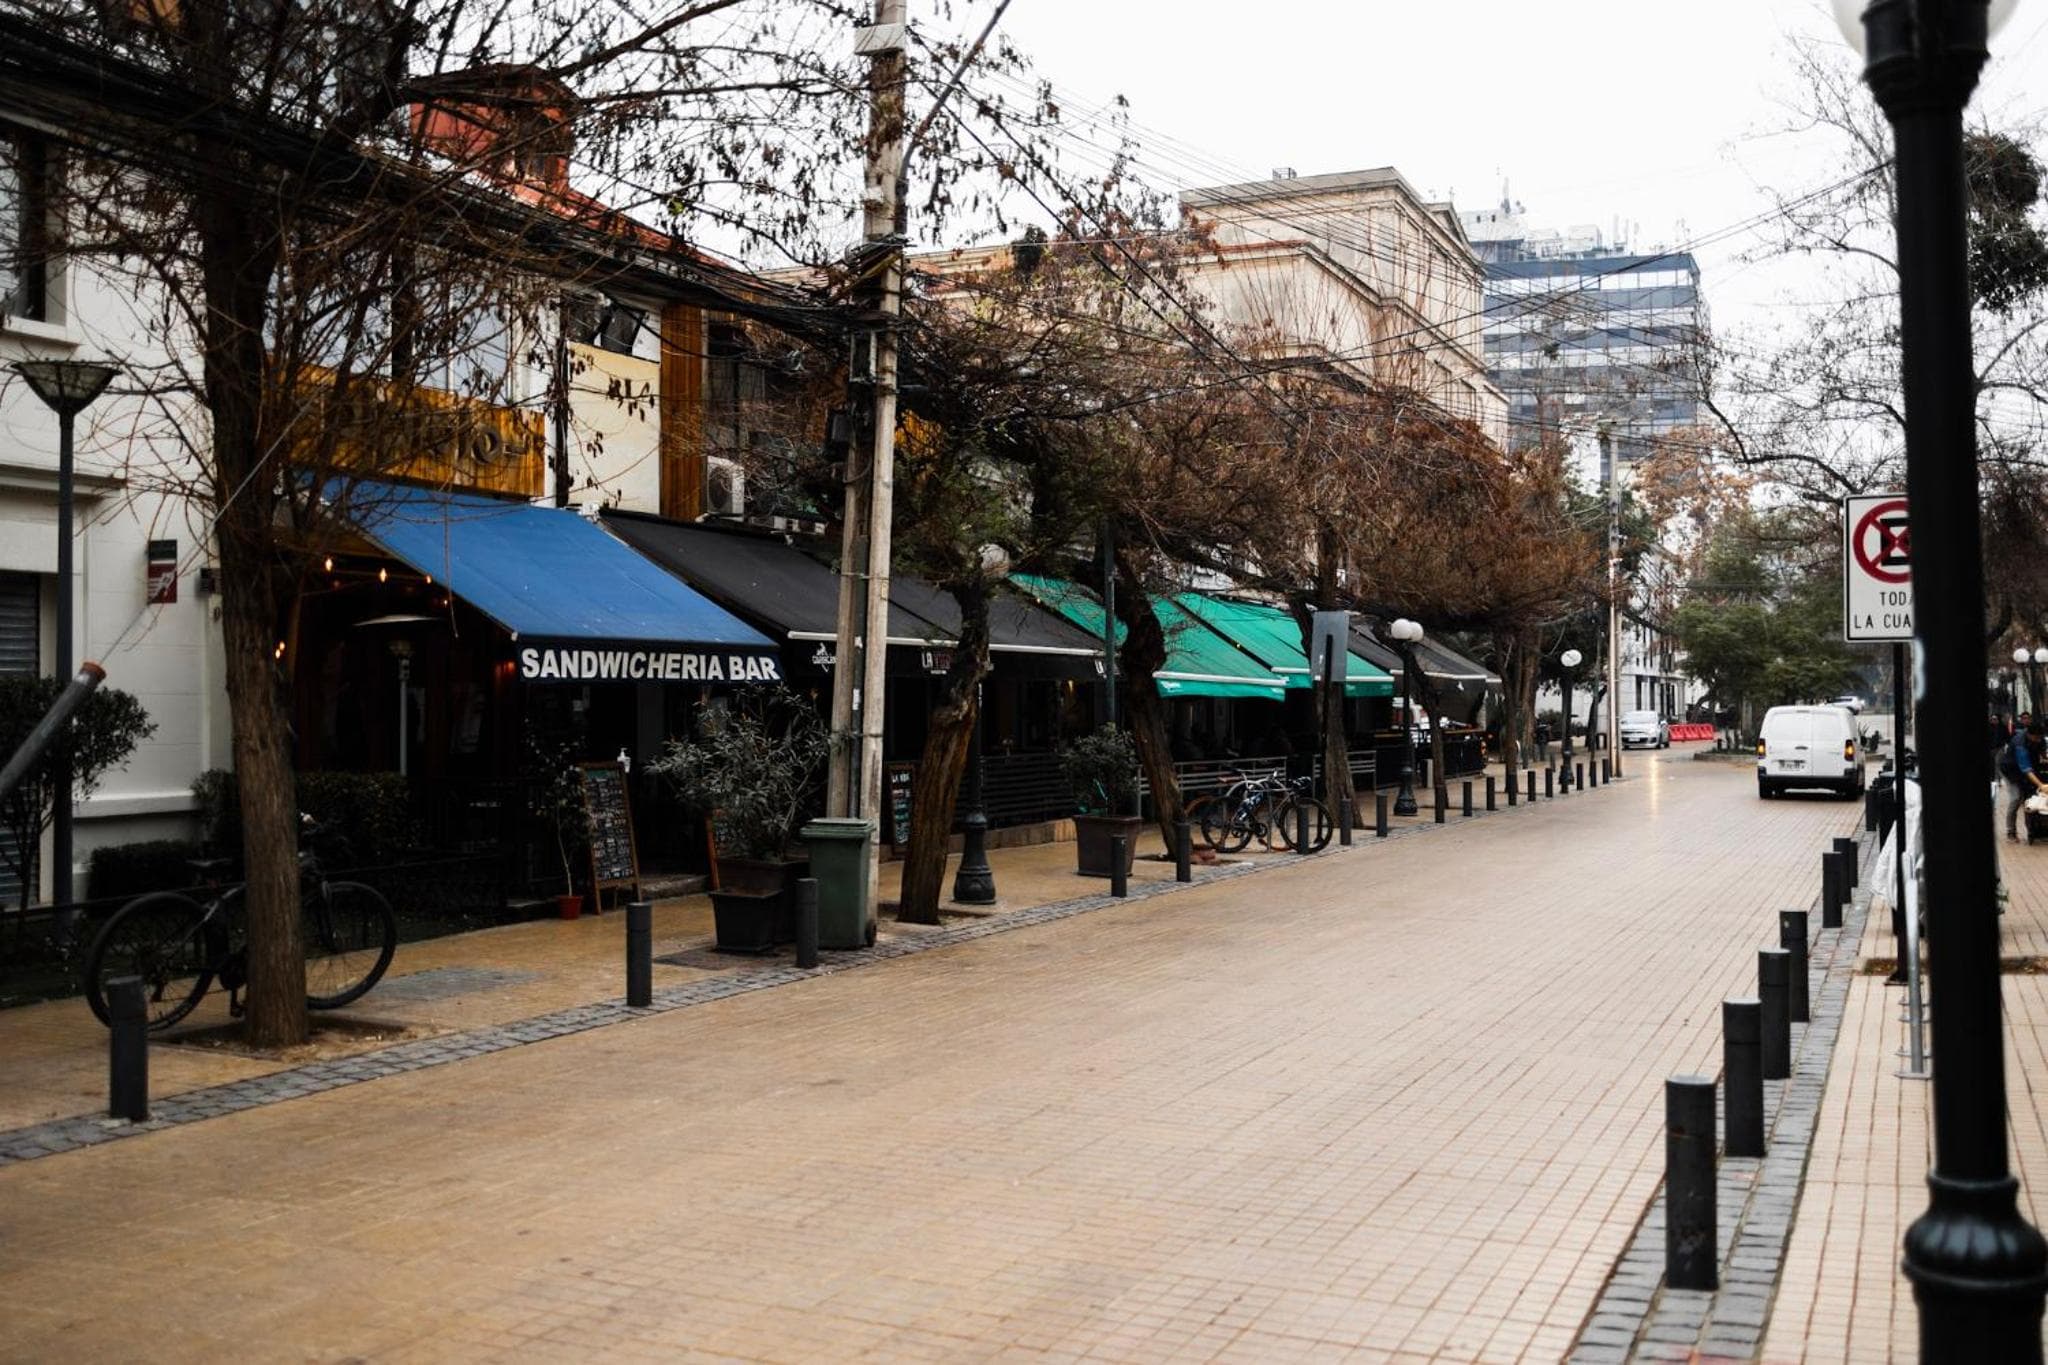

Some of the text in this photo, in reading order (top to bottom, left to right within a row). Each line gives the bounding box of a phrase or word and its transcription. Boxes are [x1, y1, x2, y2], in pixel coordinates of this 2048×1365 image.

[1854, 613, 1912, 629] LA CUA
[521, 648, 781, 681] SANDWICHERIA BAR
